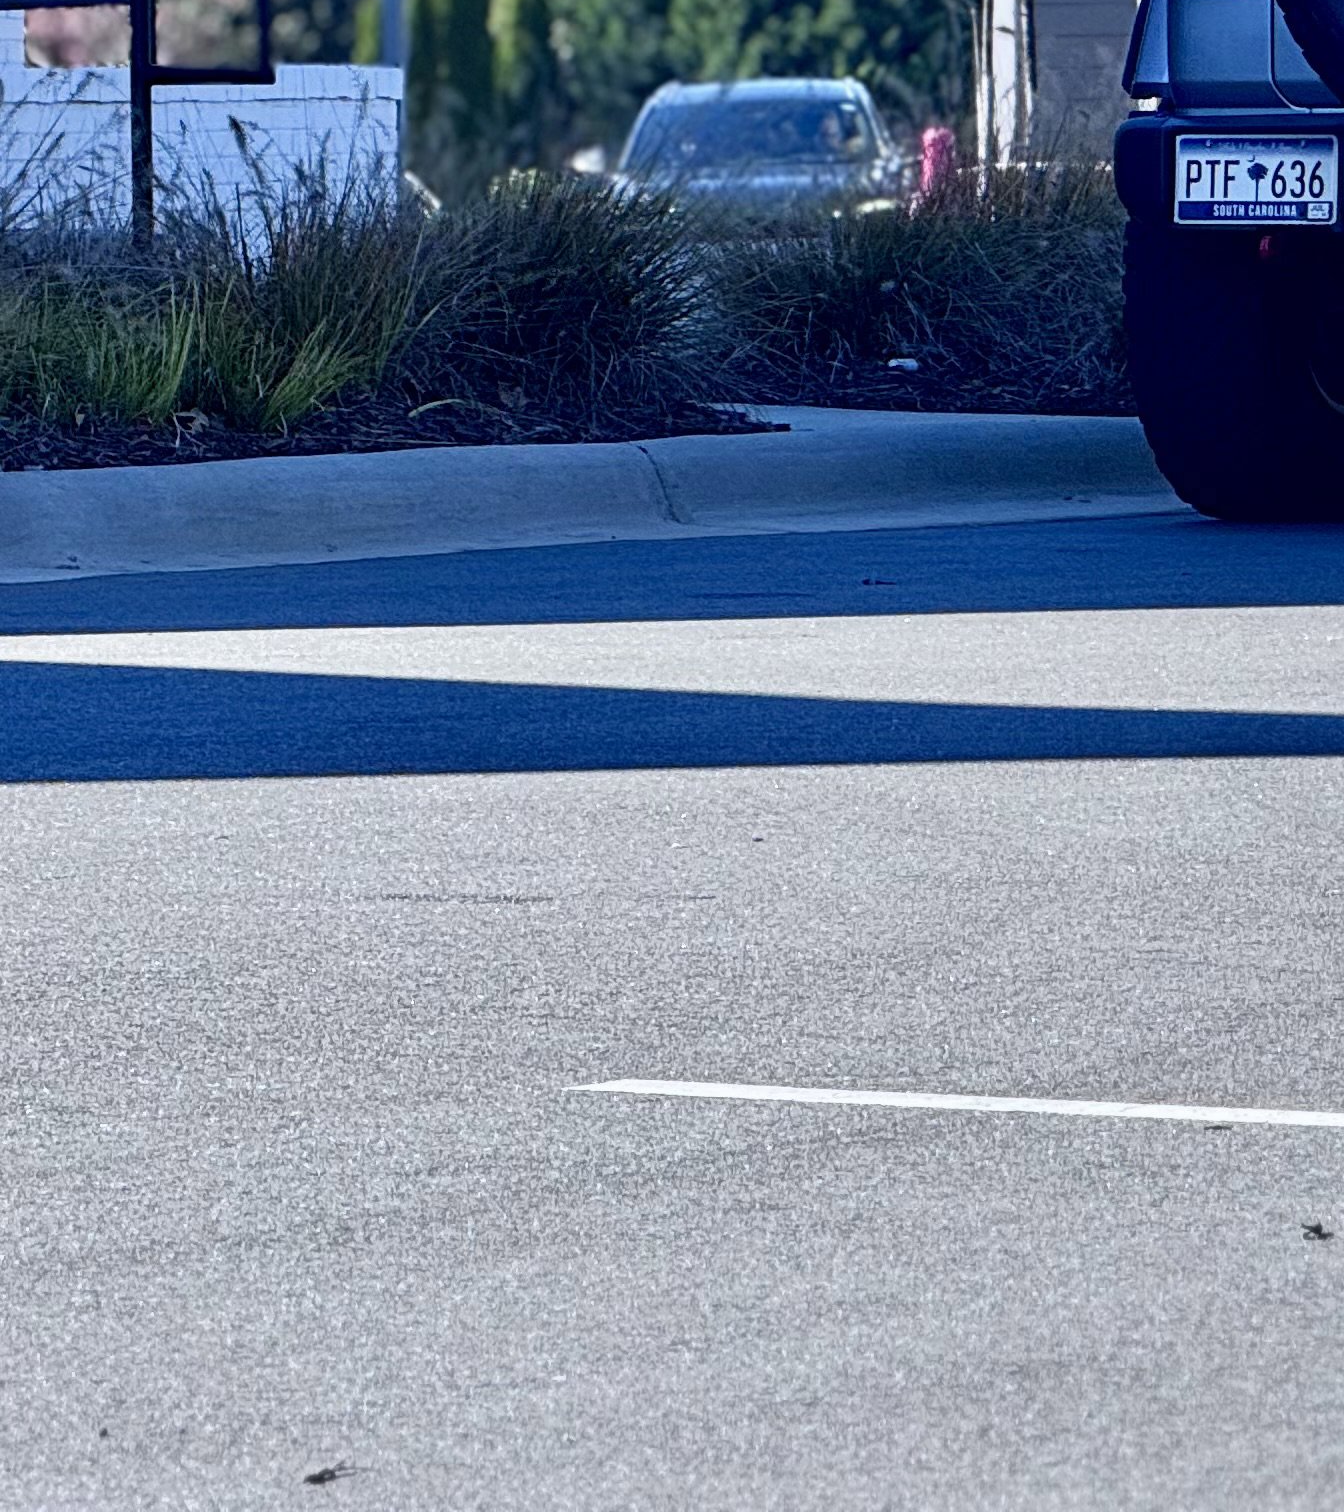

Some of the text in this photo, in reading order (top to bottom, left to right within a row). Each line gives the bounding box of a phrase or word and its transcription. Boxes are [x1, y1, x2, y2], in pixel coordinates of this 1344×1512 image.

[1185, 159, 1325, 199] PTF 636
[1213, 204, 1297, 217] SOUTH CAROLINA
